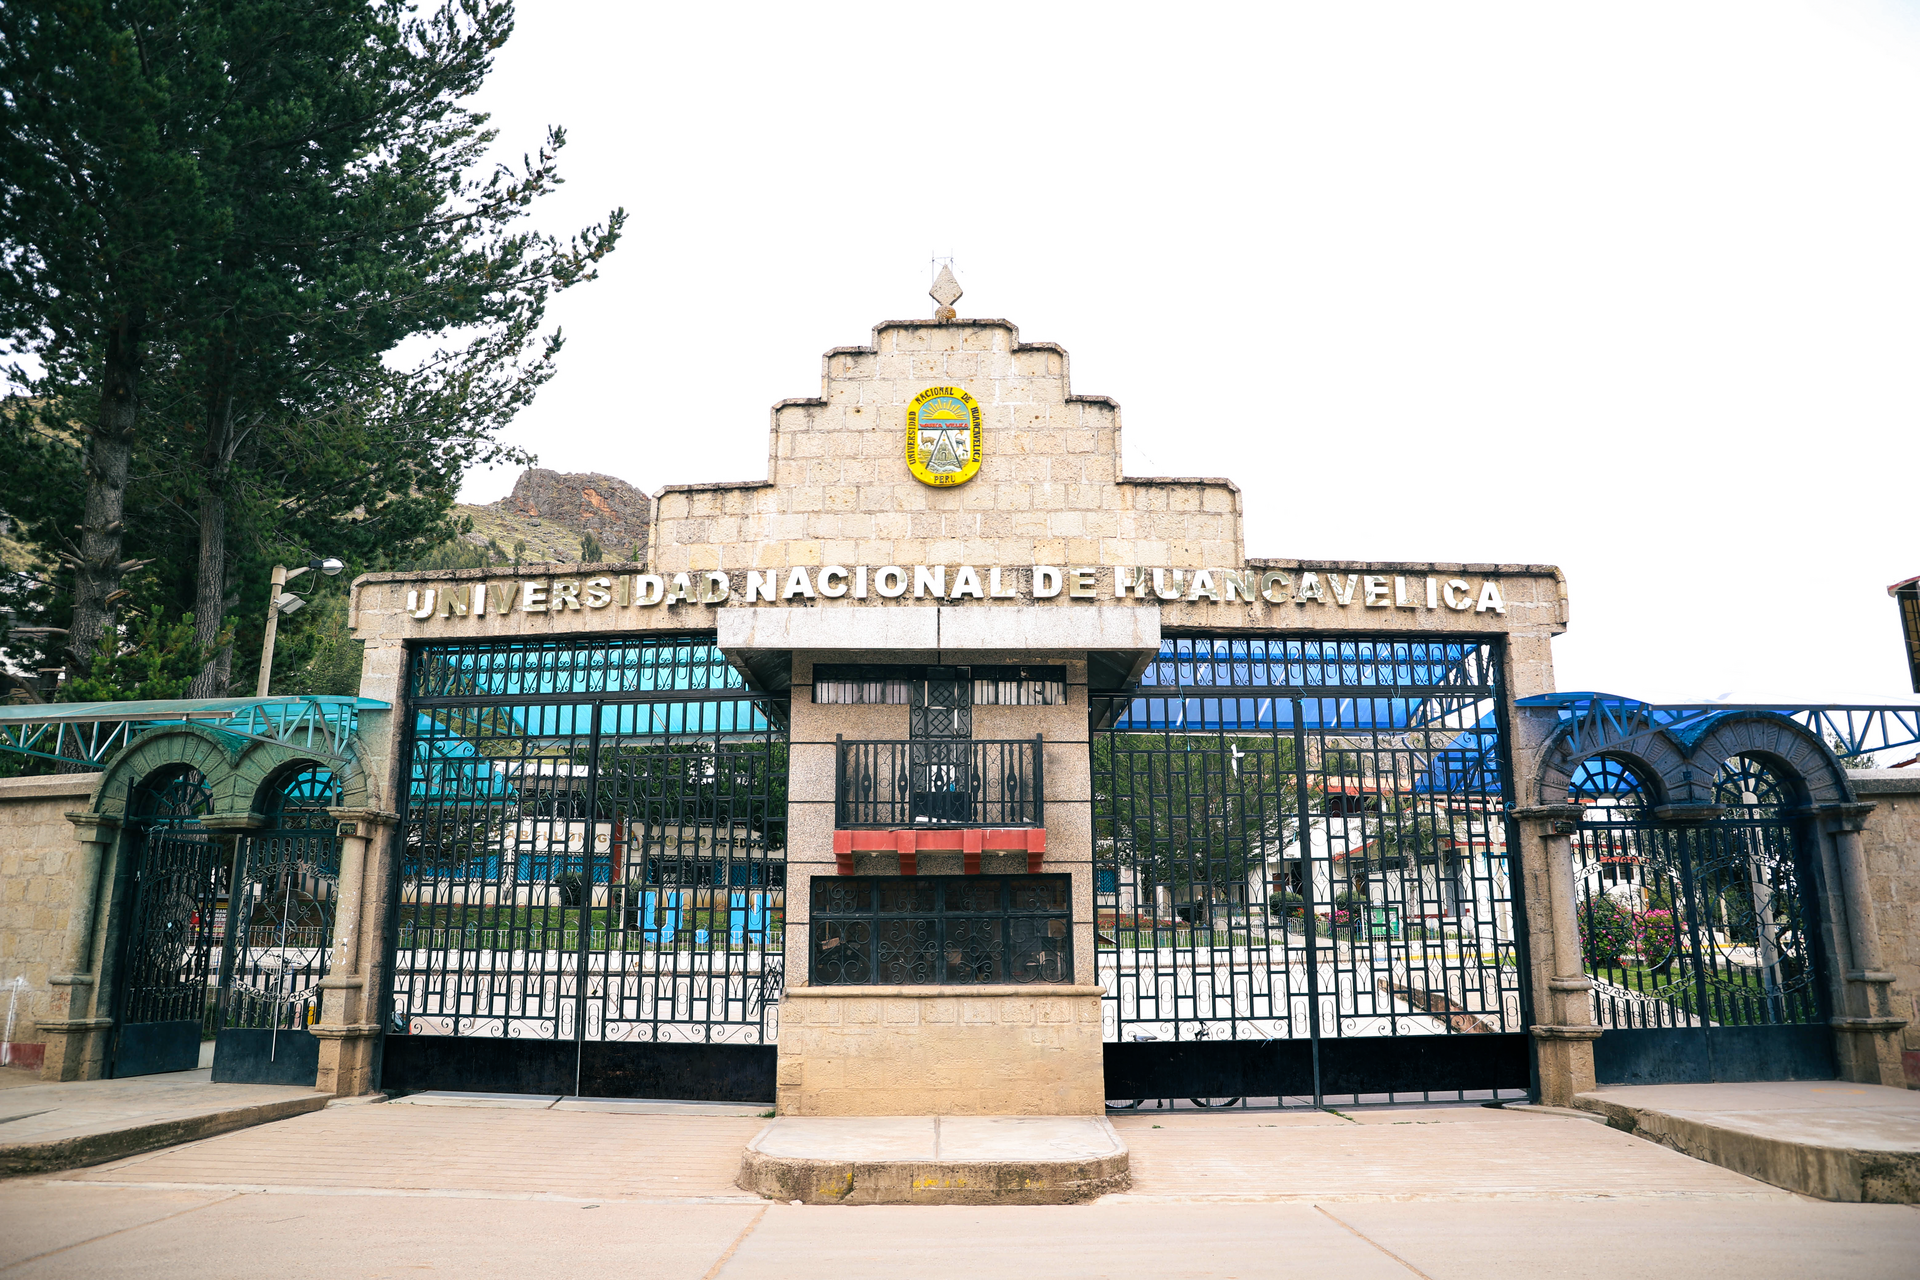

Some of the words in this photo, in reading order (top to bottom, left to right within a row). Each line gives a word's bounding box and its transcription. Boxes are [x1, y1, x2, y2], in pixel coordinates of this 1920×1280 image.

[907, 411, 917, 465] UNIVERSIDAD
[915, 386, 954, 405] NACIONAL
[960, 392, 973, 404] DE
[933, 475, 956, 484] PERU
[406, 571, 730, 619] UNIVERSIDAD
[746, 564, 1016, 603] NACIONAL
[1032, 565, 1097, 599] DE
[1115, 565, 1507, 614] HUANCAVELICA
